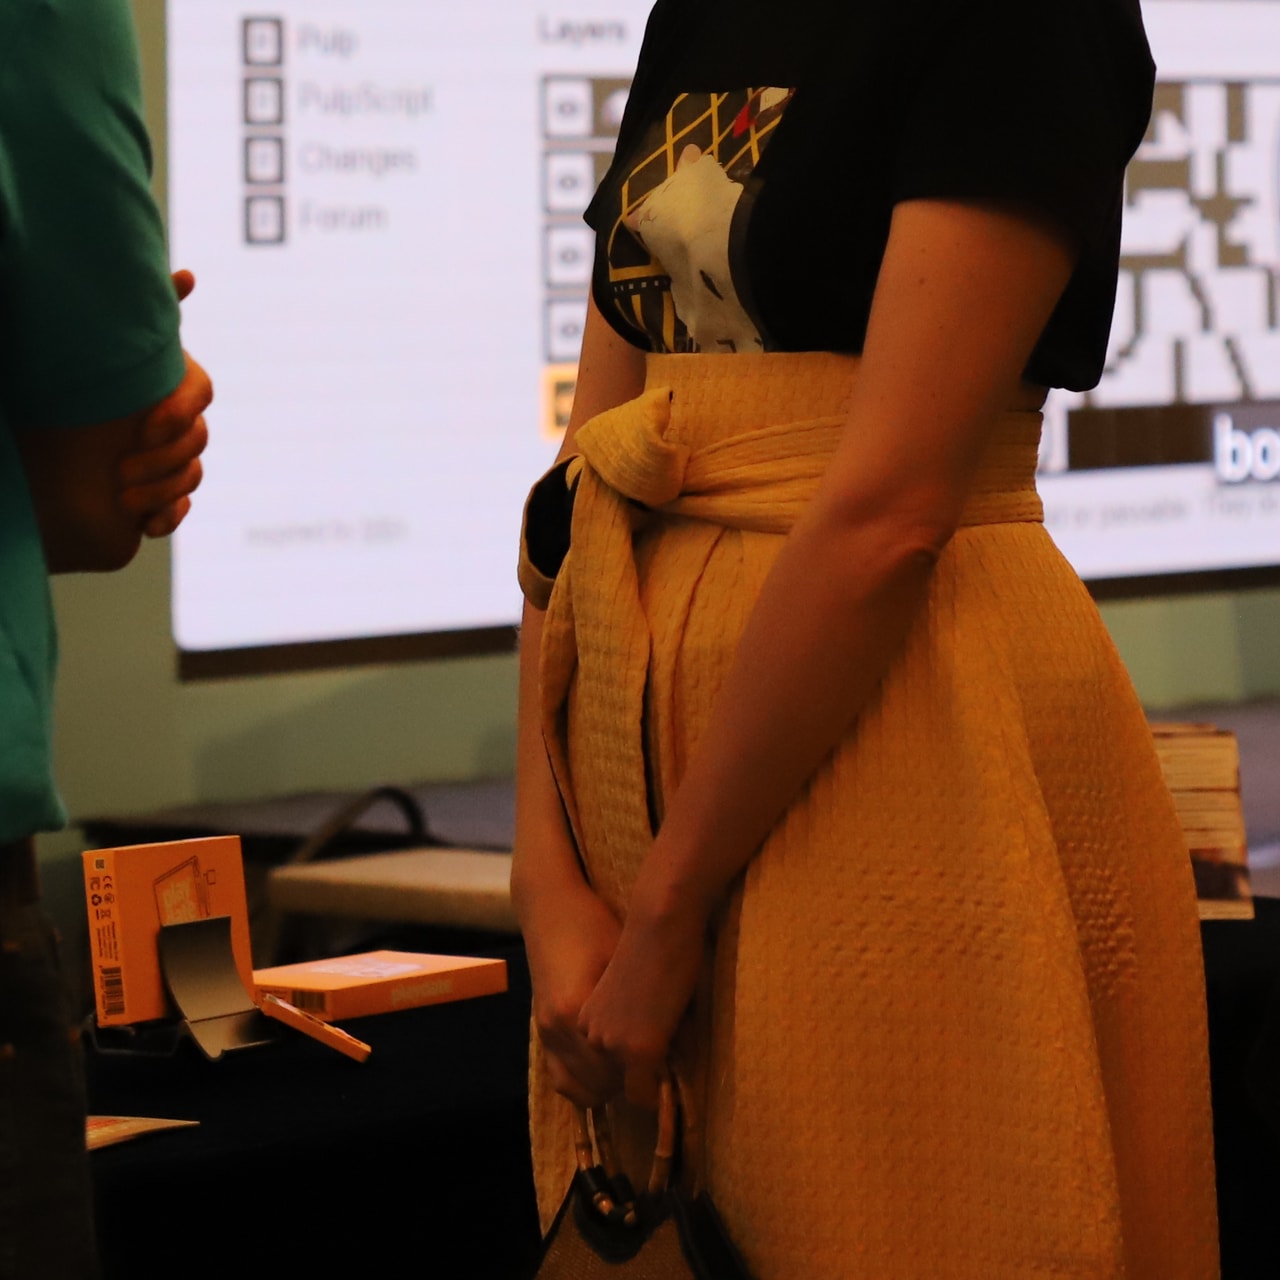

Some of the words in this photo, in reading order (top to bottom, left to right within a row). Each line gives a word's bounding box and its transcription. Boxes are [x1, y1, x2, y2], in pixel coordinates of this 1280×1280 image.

[297, 23, 357, 60] Pulp
[538, 15, 627, 46] Layers
[297, 144, 417, 178] Changes
[297, 201, 387, 232] Forum
